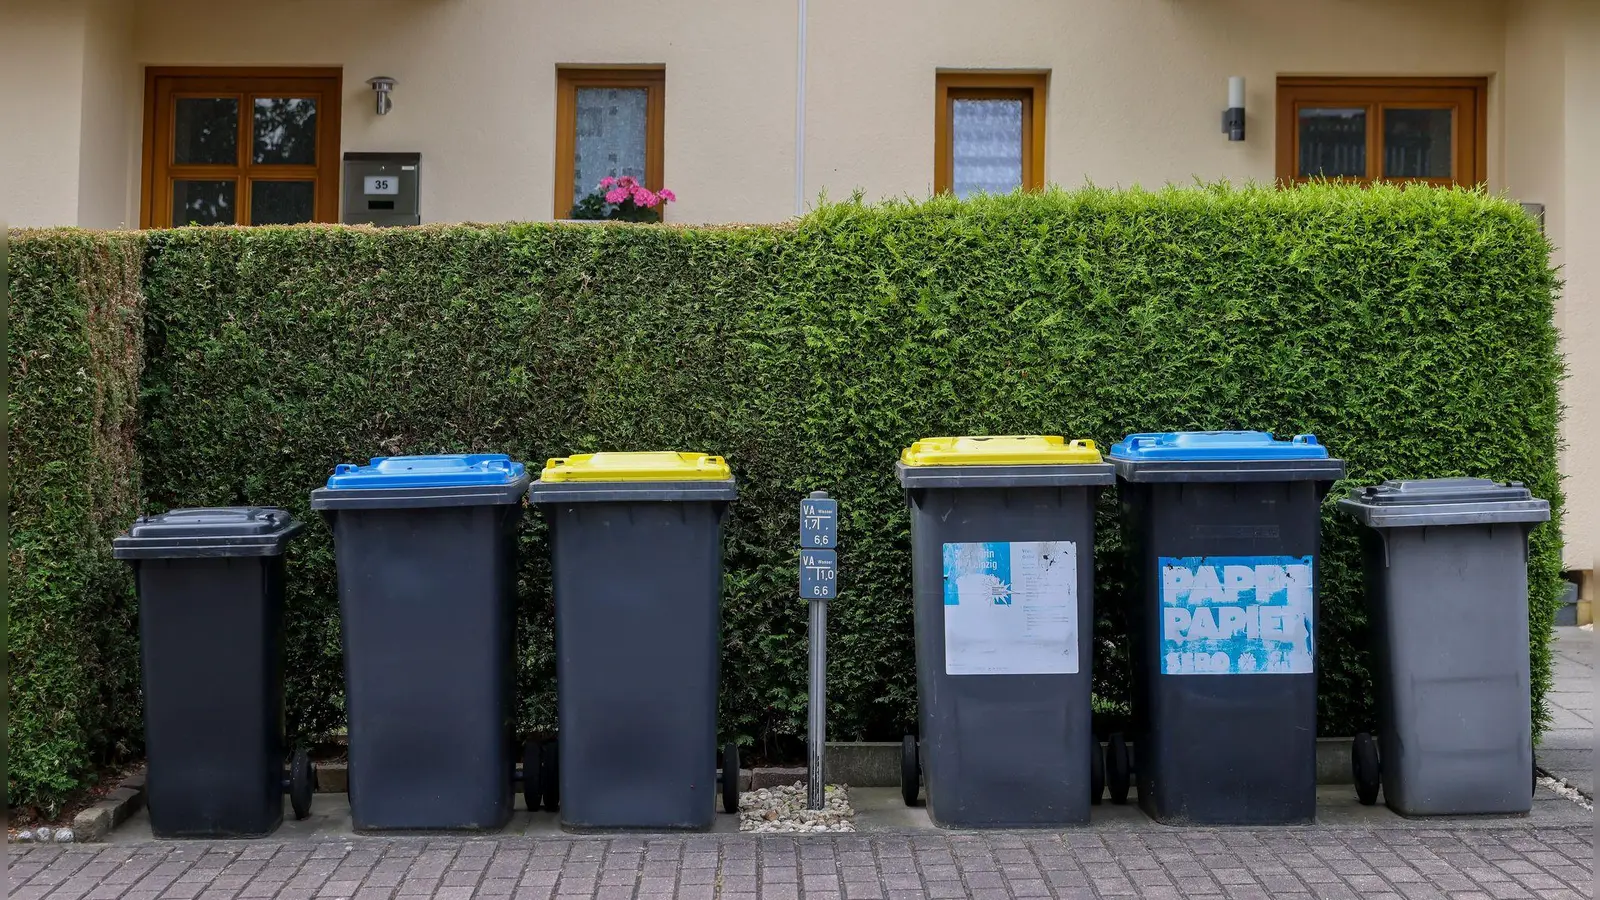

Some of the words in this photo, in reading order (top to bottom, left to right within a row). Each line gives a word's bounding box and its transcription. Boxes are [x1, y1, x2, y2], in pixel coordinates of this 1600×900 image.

[375, 180, 388, 190] 35
[803, 505, 815, 515] VA
[803, 556, 815, 566] VA
